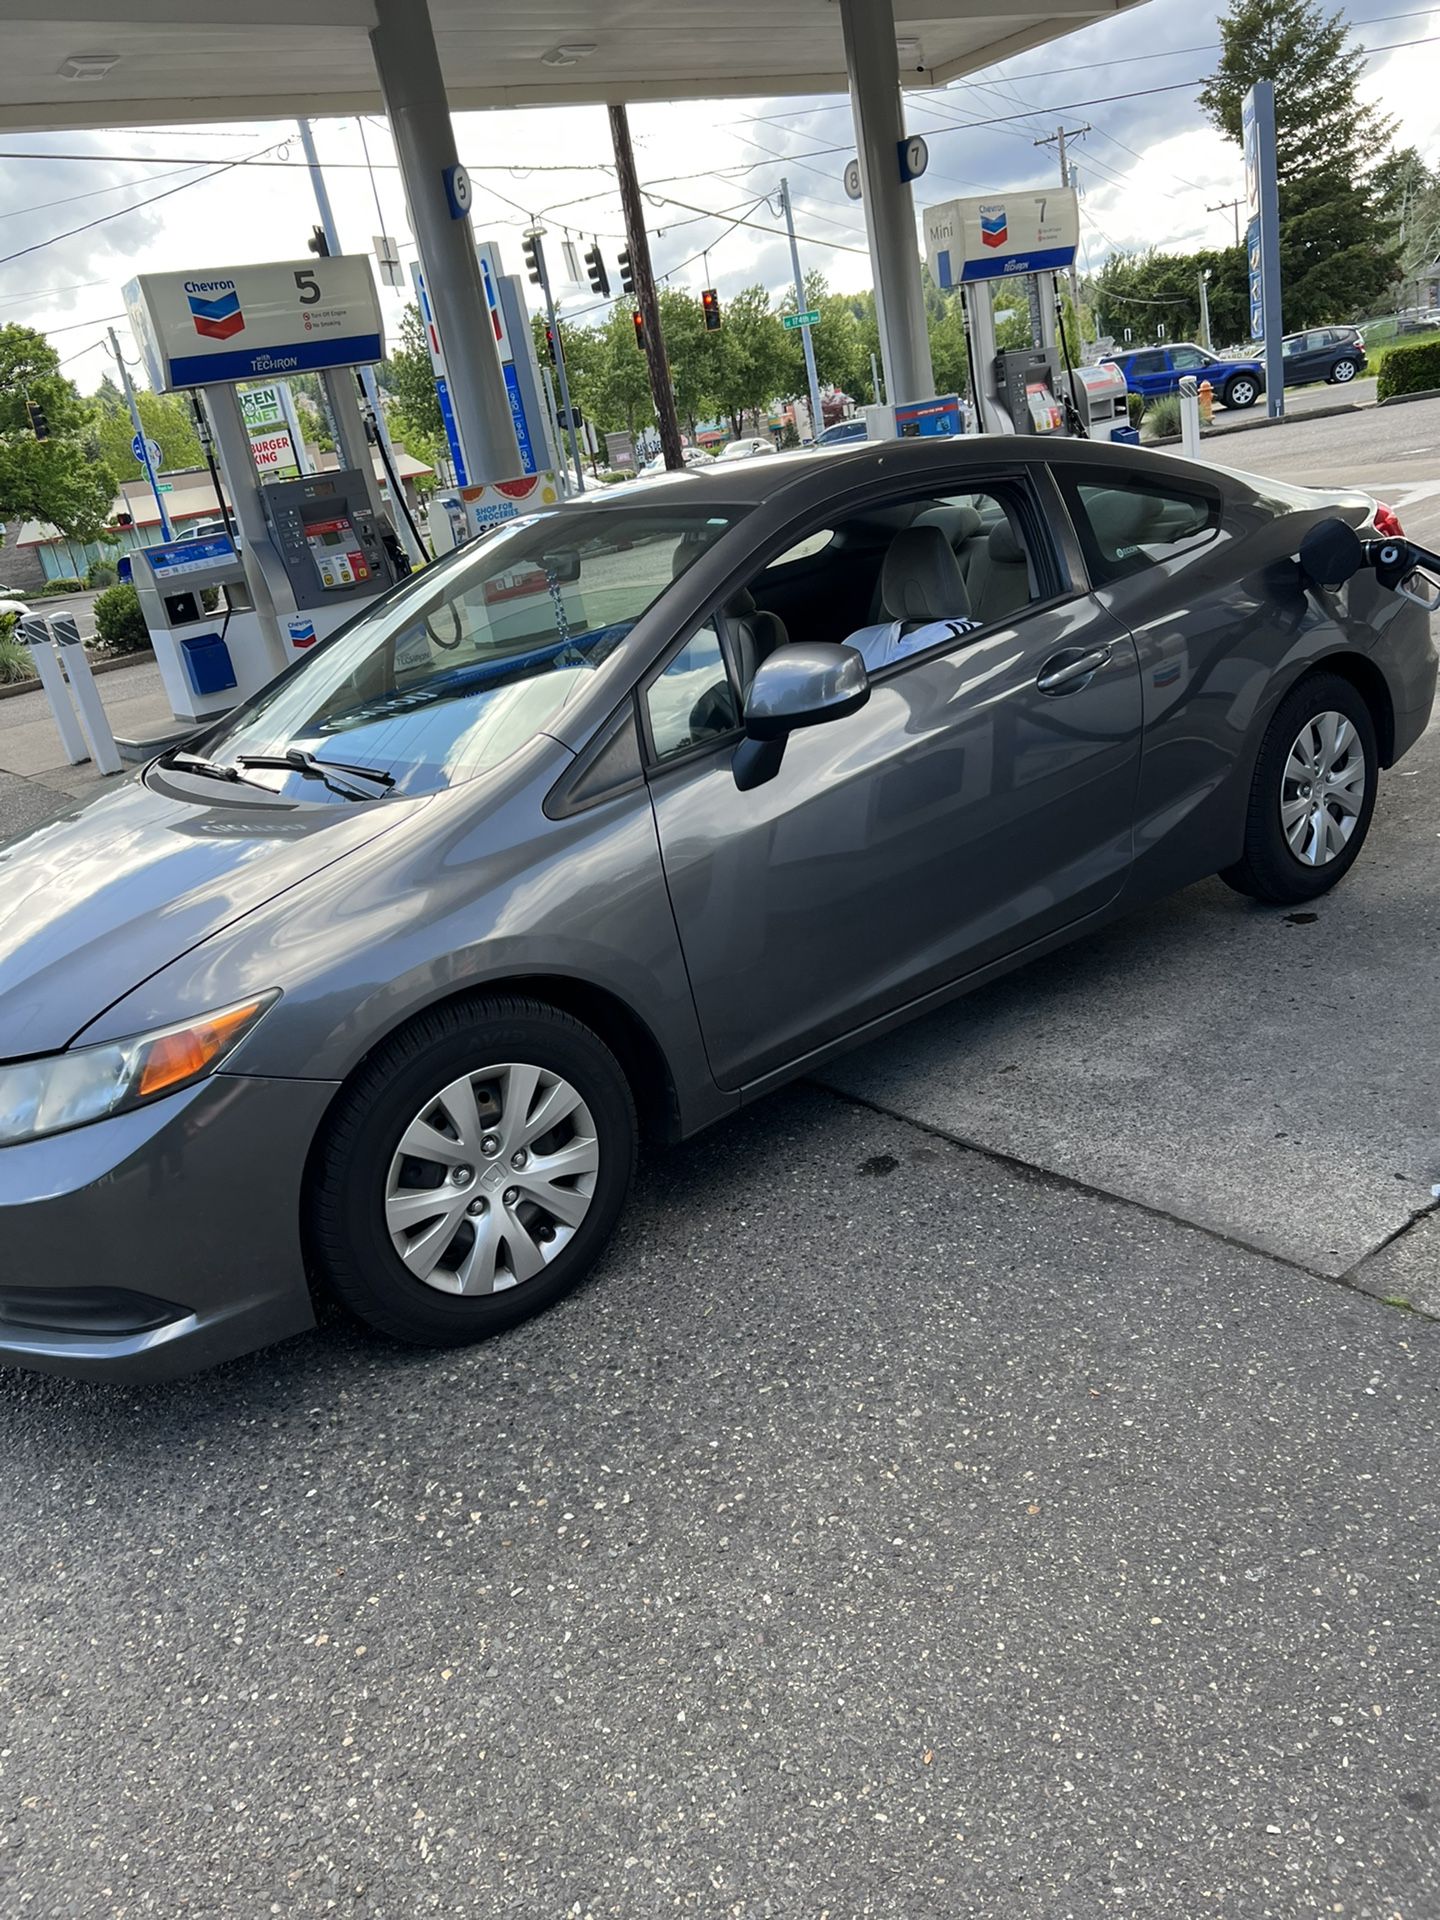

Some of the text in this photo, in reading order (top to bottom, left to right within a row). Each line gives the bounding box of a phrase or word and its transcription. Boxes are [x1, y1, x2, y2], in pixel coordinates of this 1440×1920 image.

[911, 146, 920, 167] 7
[457, 176, 467, 200] 5
[850, 171, 859, 190] 8
[978, 204, 1006, 214] Chevron
[1034, 198, 1047, 223] 7
[929, 222, 954, 241] Mini
[183, 279, 235, 294] Chevron
[293, 269, 321, 305] 5
[250, 356, 298, 372] TECHRON
[250, 436, 290, 453] BURGER
[254, 451, 278, 465] KING
[475, 502, 514, 516] SHOP FOR
[477, 508, 519, 523] GROCERIES
